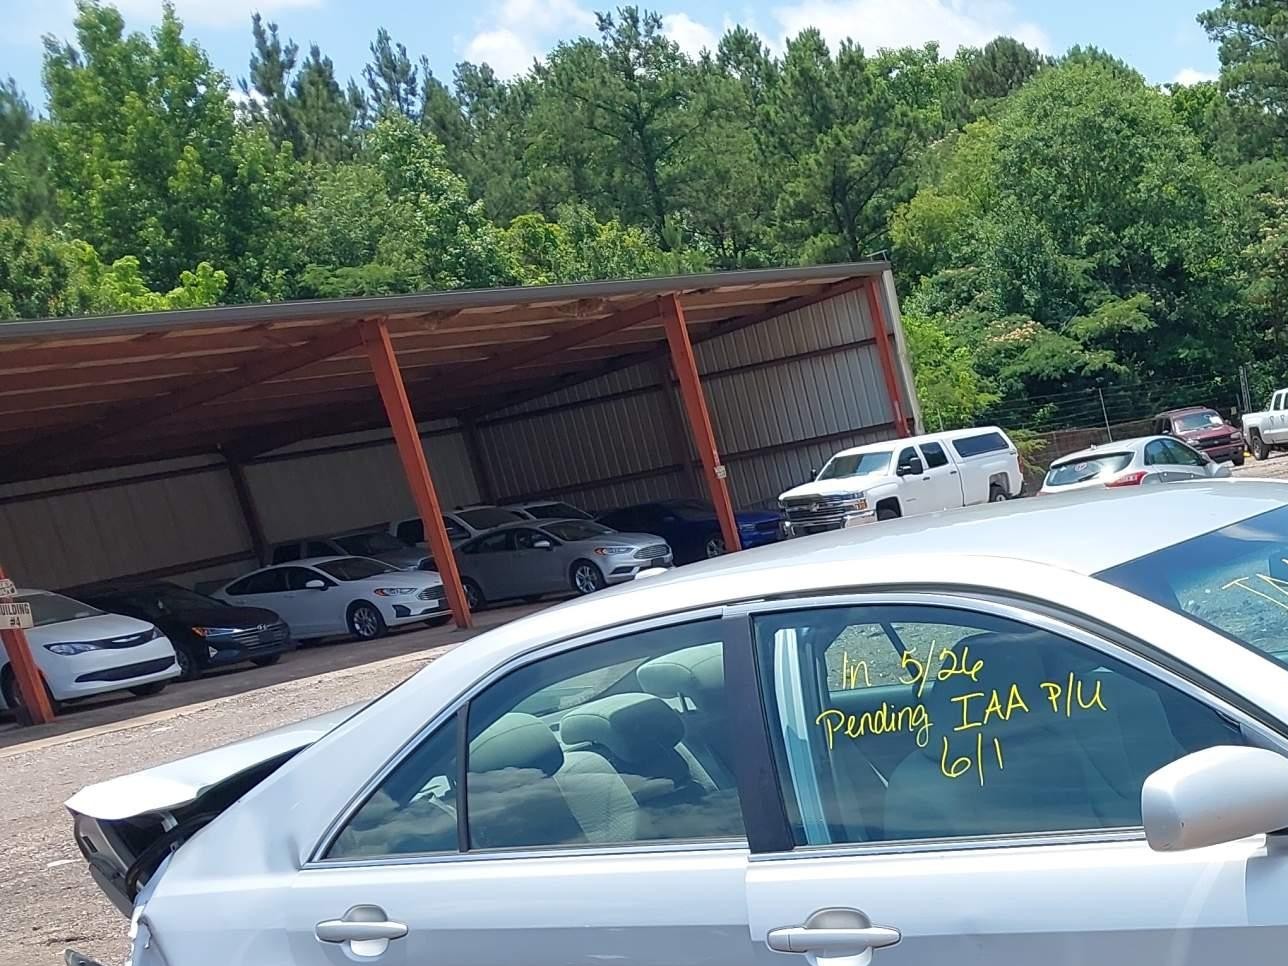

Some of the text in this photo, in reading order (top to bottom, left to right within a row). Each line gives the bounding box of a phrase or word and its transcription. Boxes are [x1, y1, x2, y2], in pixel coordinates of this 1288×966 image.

[0, 603, 30, 616] UILDING
[843, 640, 984, 698] In 5/26
[816, 672, 1107, 749] Pending IAA P/U
[940, 733, 1004, 786] 6/1
